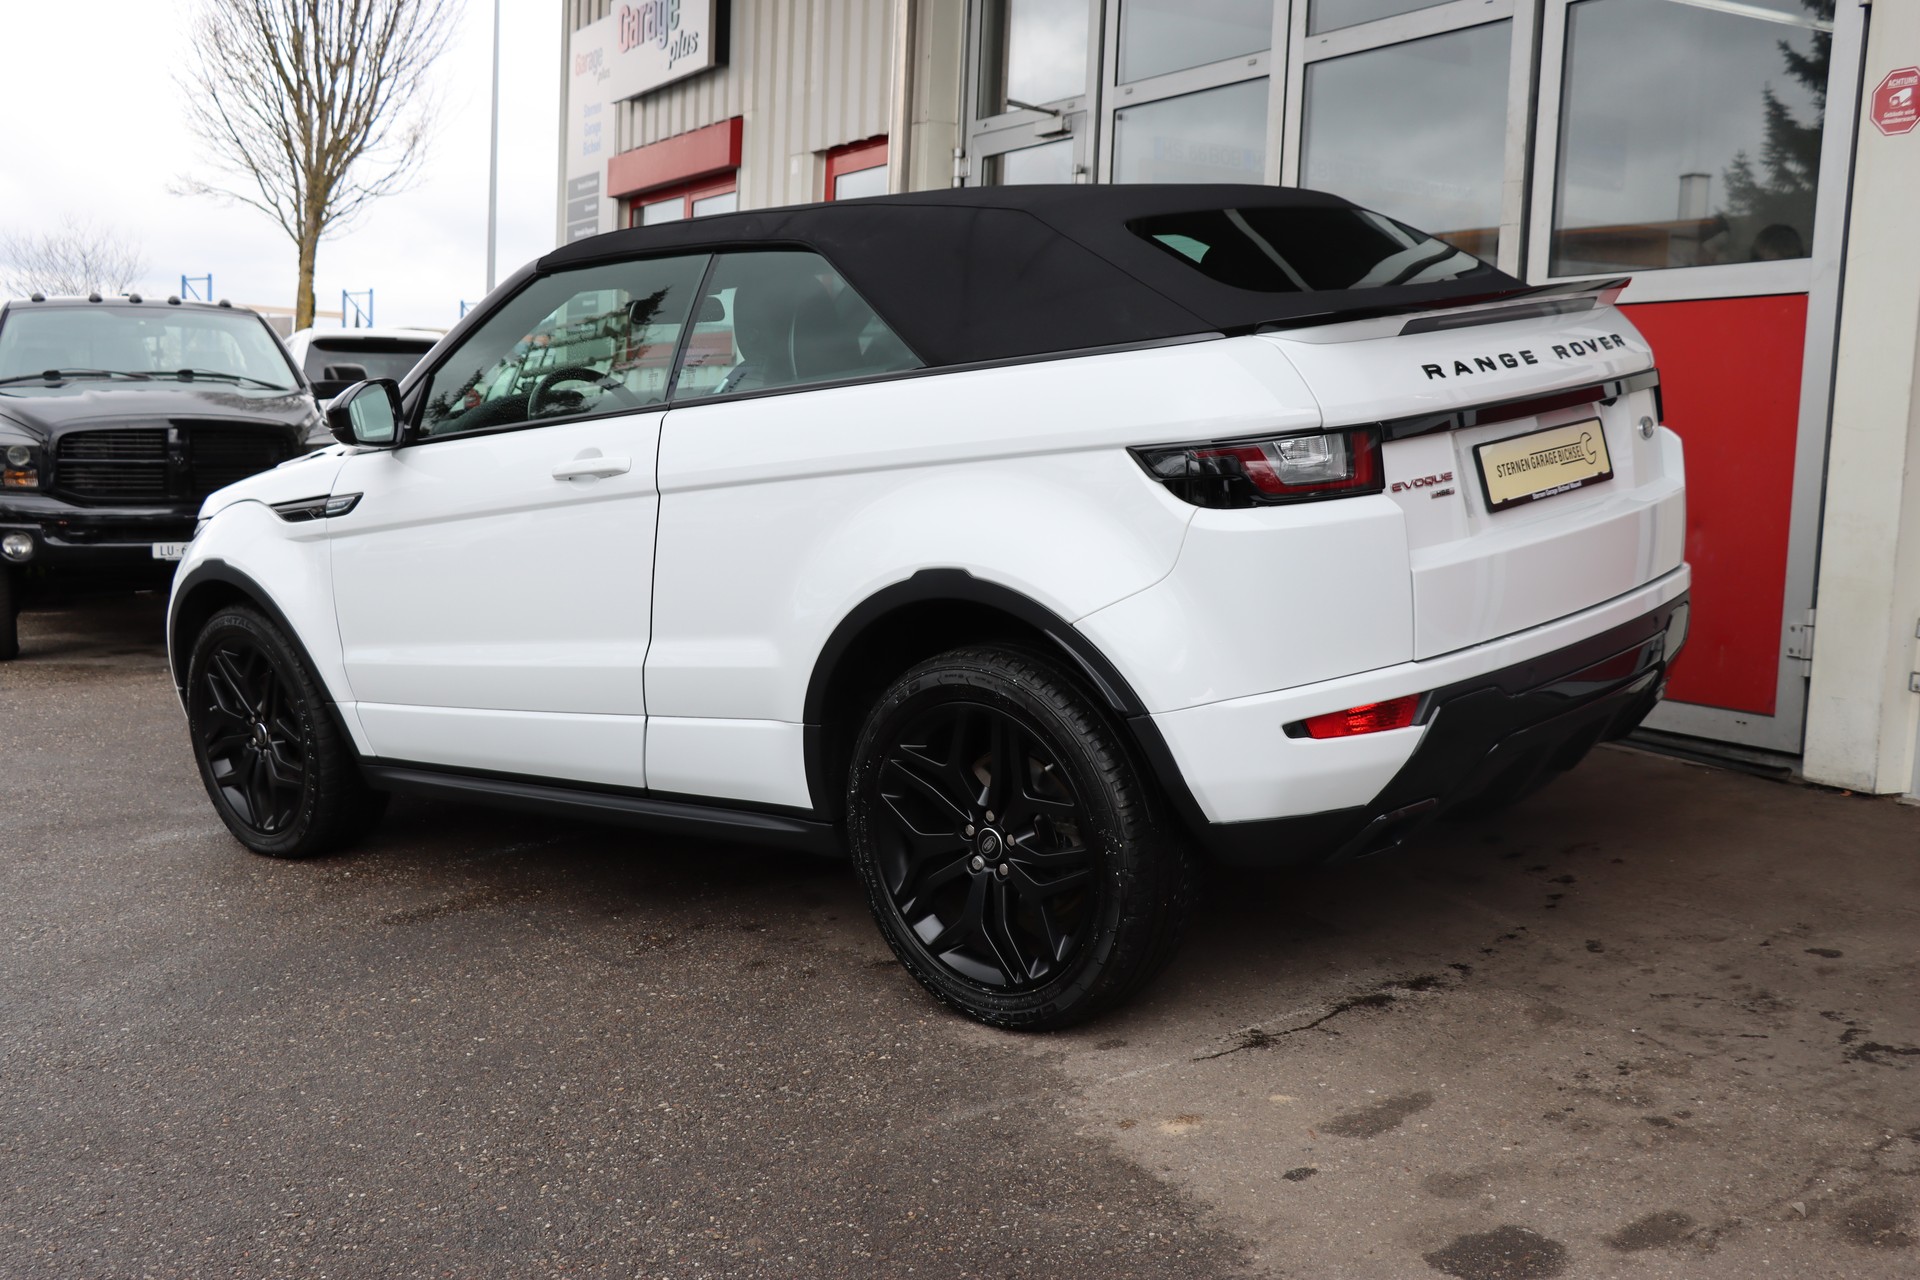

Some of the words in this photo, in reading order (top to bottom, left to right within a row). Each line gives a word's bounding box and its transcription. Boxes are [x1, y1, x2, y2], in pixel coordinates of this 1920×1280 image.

[618, 0, 680, 54] Garage
[668, 29, 699, 71] plus
[1887, 76, 1918, 88] ACHTUNG
[1421, 349, 1539, 380] RANGE
[1551, 333, 1626, 360] ROVER
[1496, 457, 1531, 478] STERNEN
[1530, 451, 1558, 469] GARAGE
[1557, 445, 1584, 462] BICHSEL
[1390, 471, 1453, 493] EVOQUE
